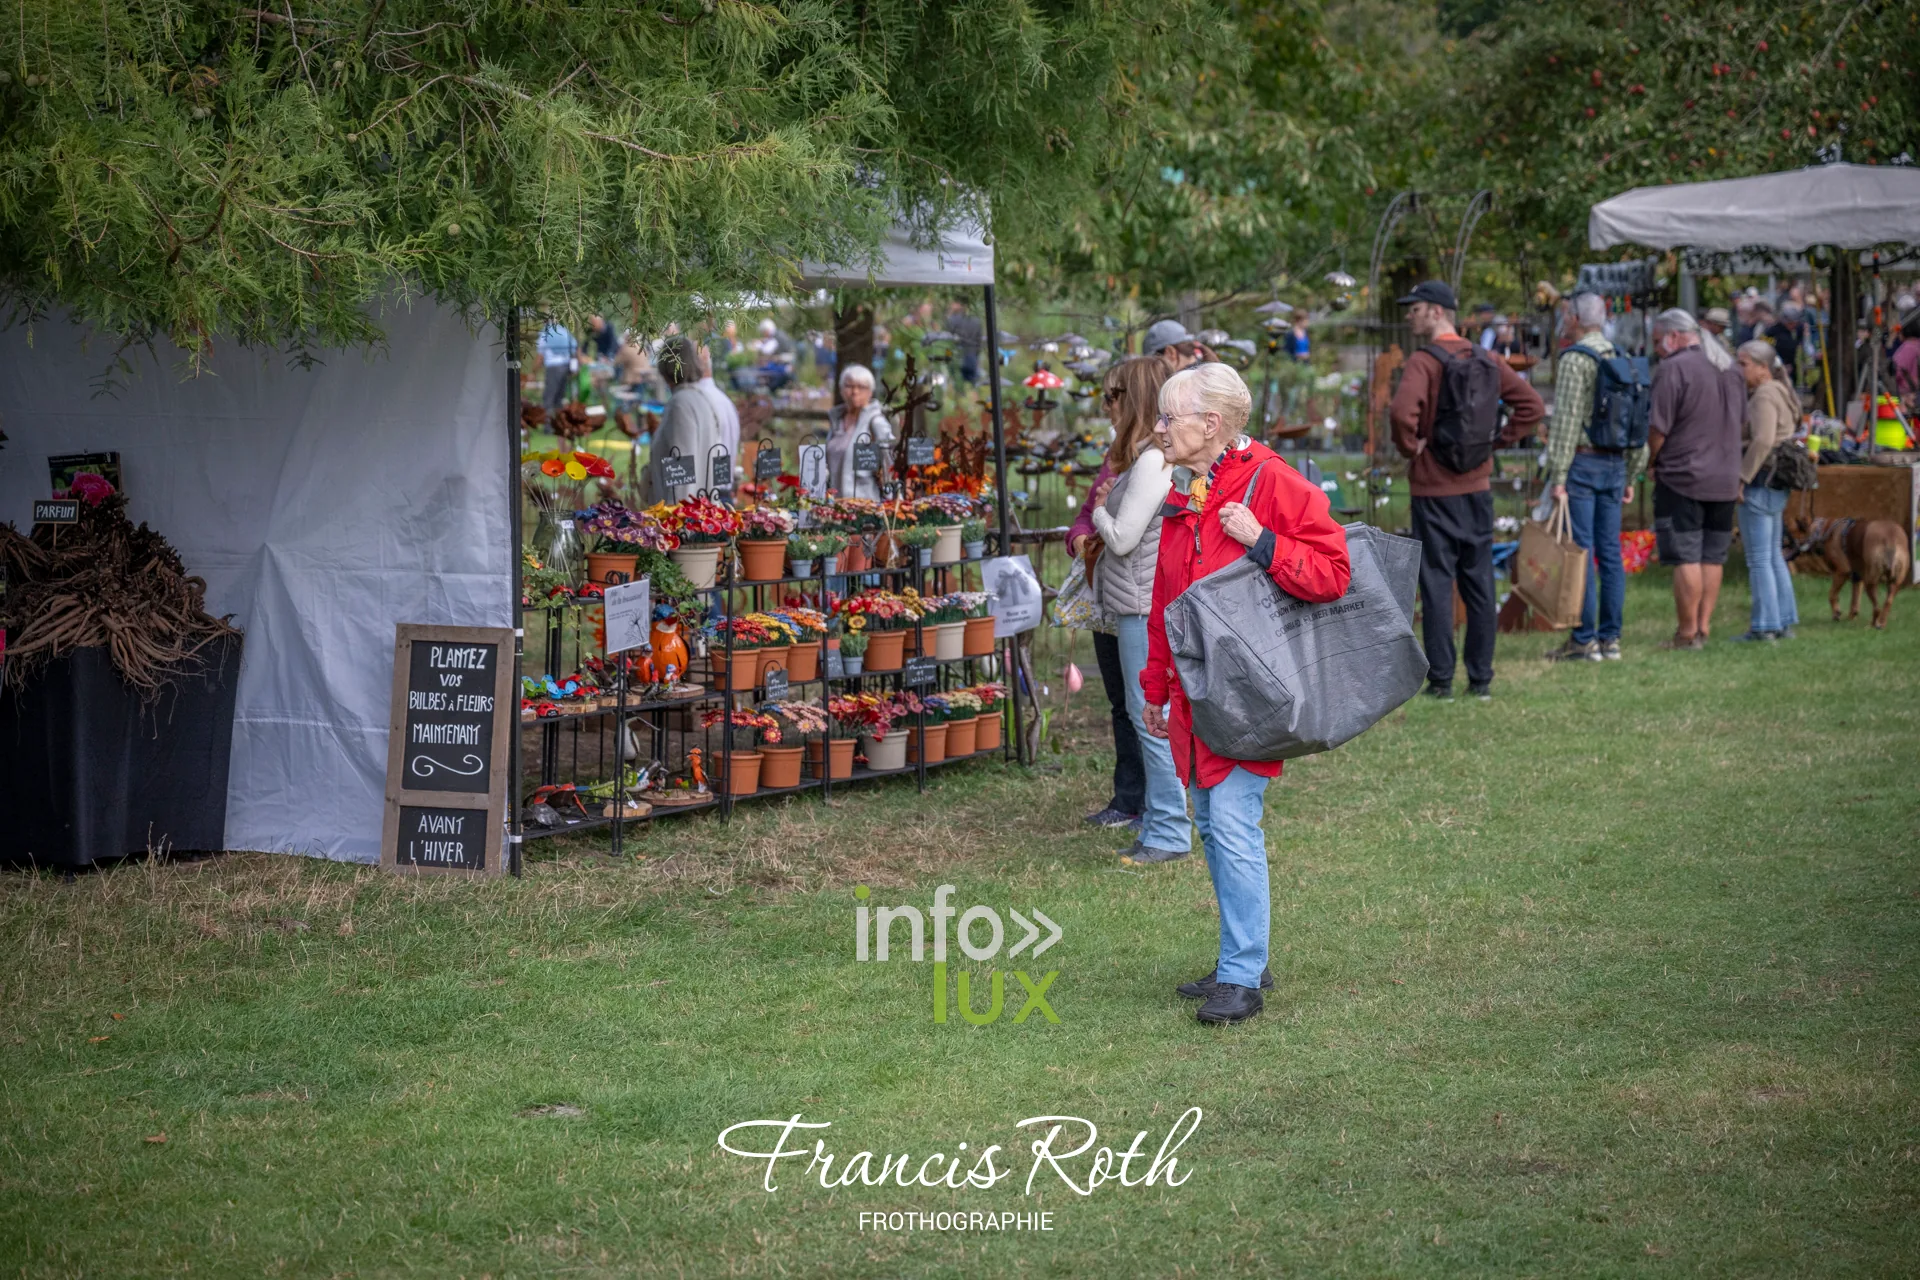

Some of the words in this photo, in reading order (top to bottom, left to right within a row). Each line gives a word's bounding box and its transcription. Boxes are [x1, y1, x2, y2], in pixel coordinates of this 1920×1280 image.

[36, 505, 76, 519] PARFUM
[1329, 600, 1365, 616] MARKET
[430, 646, 488, 669] PLANTEZ
[439, 674, 463, 687] VOS
[409, 691, 447, 711] BULBES
[456, 694, 494, 712] FLEURS
[413, 723, 481, 745] MAINTENANT
[418, 814, 465, 835] AVANT
